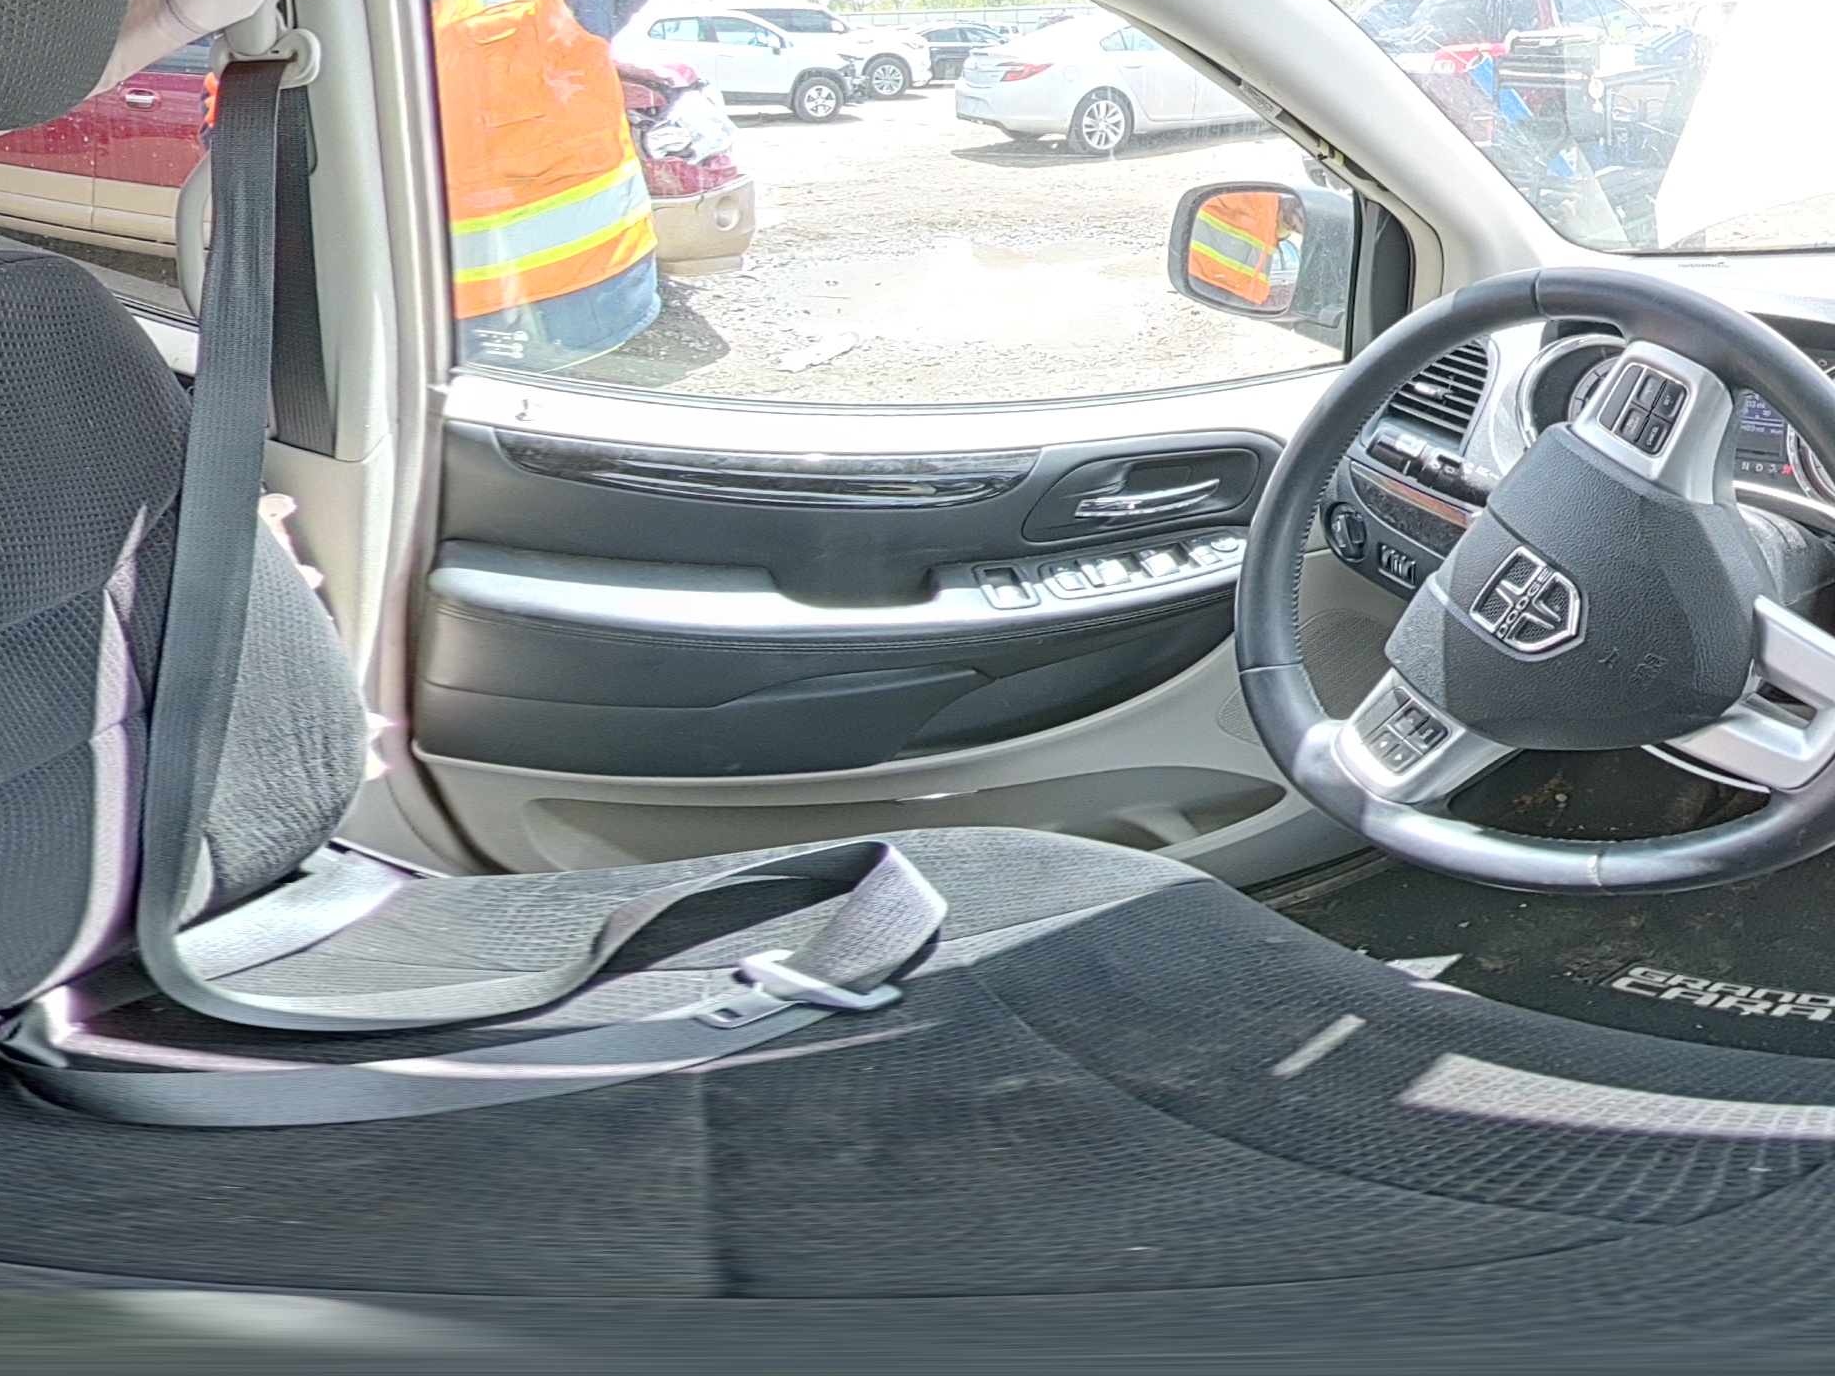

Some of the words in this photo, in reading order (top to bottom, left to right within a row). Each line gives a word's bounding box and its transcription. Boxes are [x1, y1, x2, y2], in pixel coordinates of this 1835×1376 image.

[1742, 462, 1749, 470] N
[1756, 464, 1763, 472] D
[1497, 568, 1552, 639] DODGE
[1612, 977, 1835, 1022] CARA
